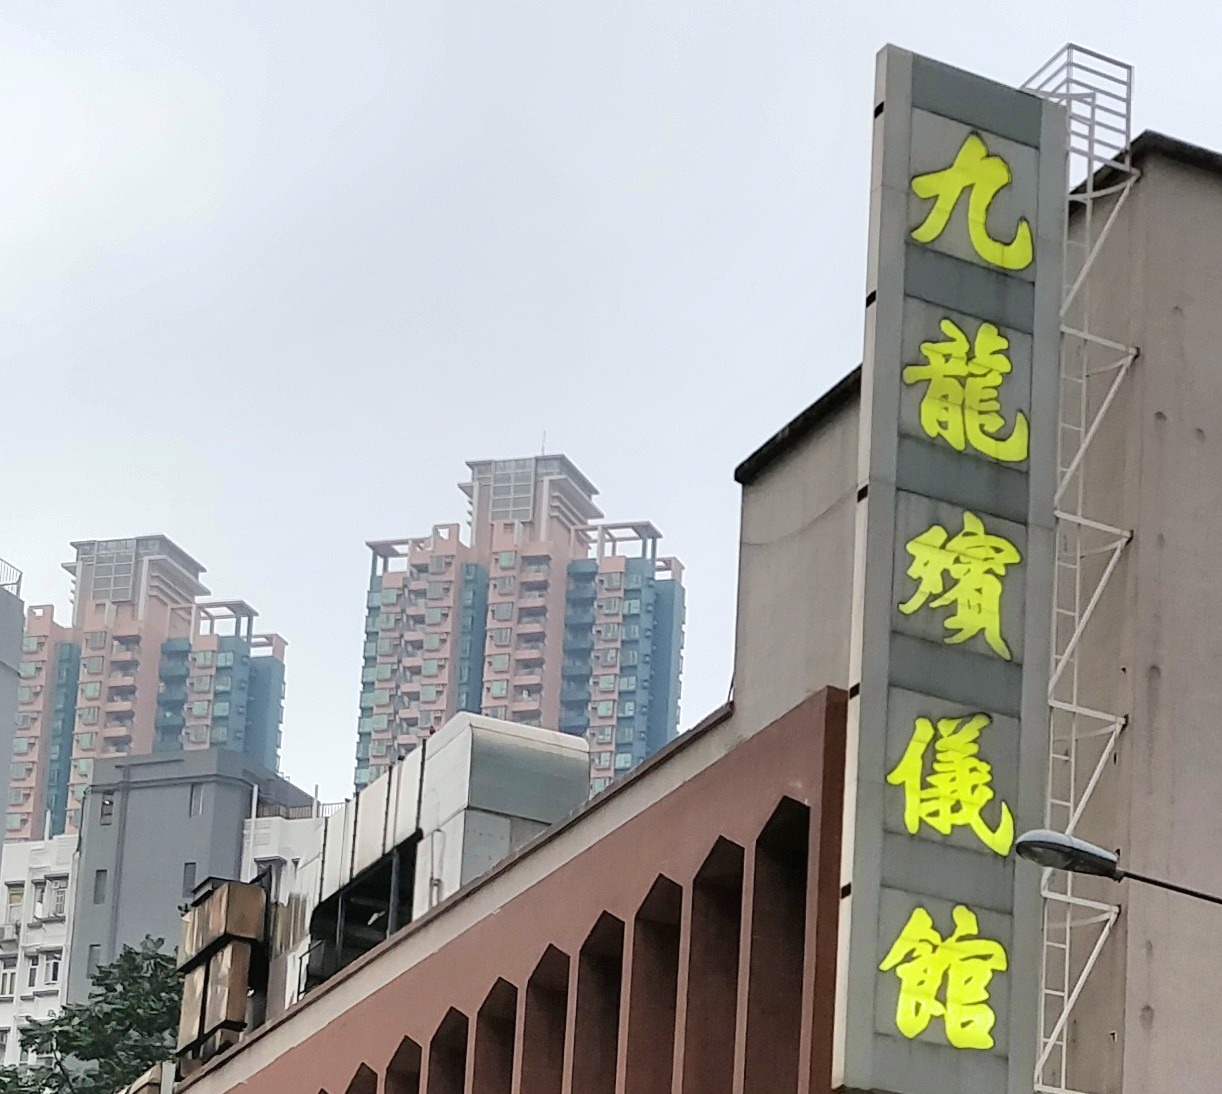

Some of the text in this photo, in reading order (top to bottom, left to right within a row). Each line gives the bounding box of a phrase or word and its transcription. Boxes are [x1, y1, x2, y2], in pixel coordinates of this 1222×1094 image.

[879, 132, 1034, 1050] 九龍殯儀館
